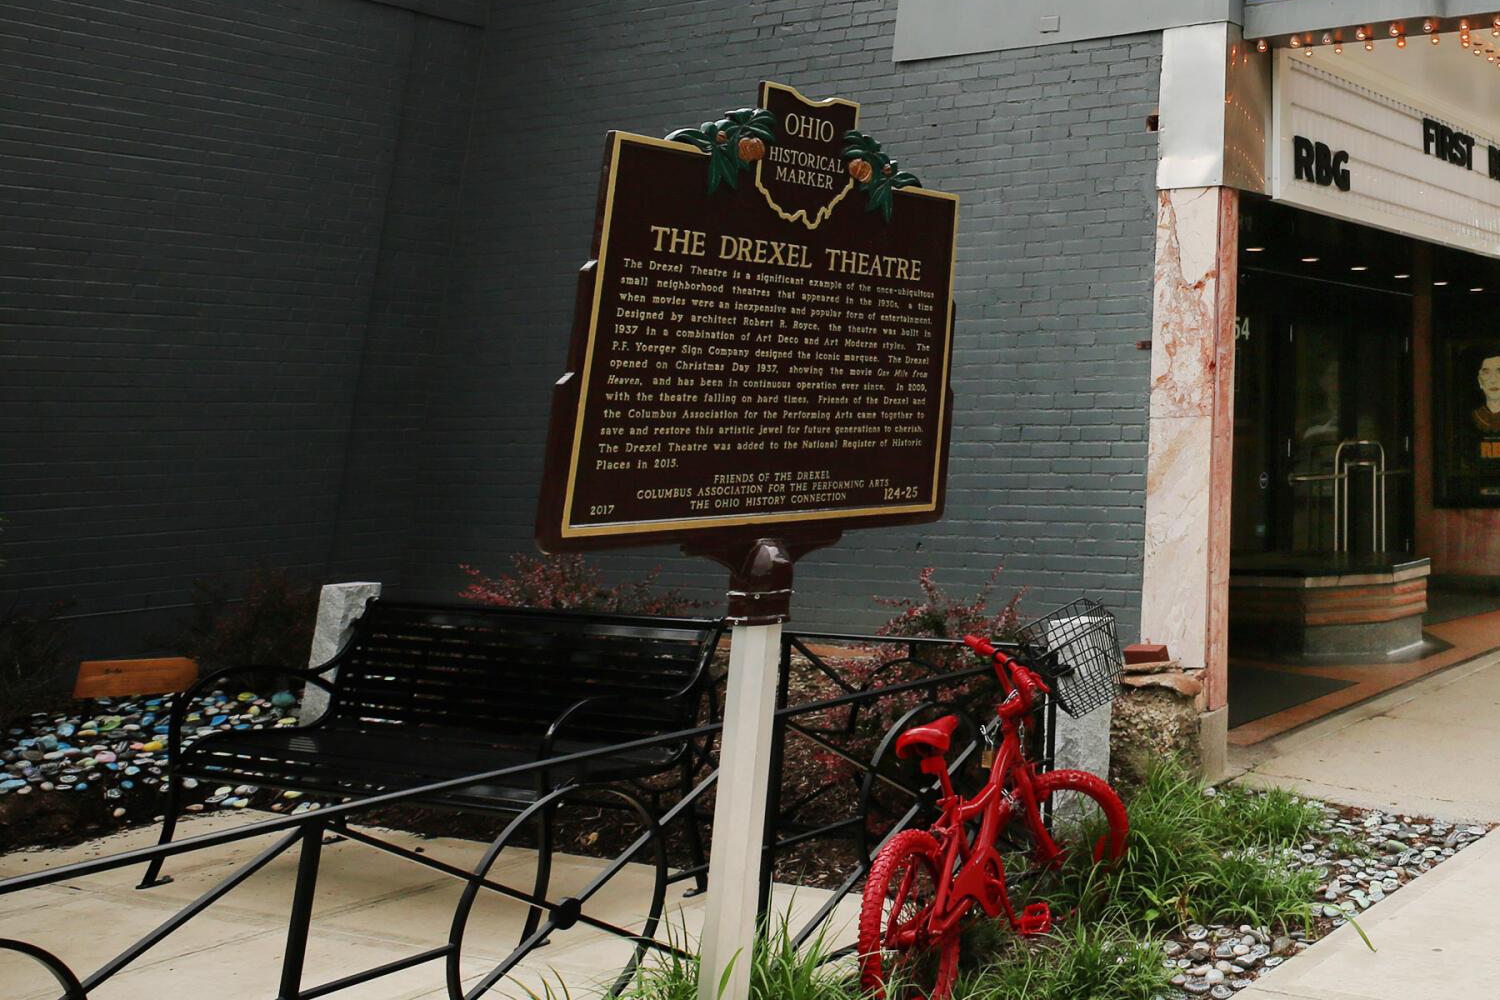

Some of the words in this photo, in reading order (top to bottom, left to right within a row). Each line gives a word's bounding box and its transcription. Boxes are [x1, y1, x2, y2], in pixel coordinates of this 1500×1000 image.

[784, 112, 835, 144] OHIO
[1423, 117, 1475, 171] FIRST
[769, 146, 845, 174] HISTORICAL
[1293, 135, 1351, 192] RBG
[776, 165, 834, 191] MARKER
[649, 224, 707, 257] THE
[717, 234, 813, 269] DREXEL
[824, 247, 922, 281] THEATRE
[623, 257, 642, 269] The
[649, 260, 683, 273] Drexel
[690, 265, 727, 277] Theatre
[732, 269, 740, 279] is
[745, 272, 751, 280] a
[756, 272, 804, 285] significant
[808, 279, 842, 290] example
[846, 282, 855, 290] of
[858, 283, 871, 292] the
[620, 276, 648, 286] small
[656, 279, 724, 293] neighborhood
[732, 285, 770, 297] theatres
[777, 290, 795, 299] that
[801, 293, 840, 303] appeared
[845, 295, 854, 304] in
[859, 297, 872, 306] the
[619, 292, 646, 302] when
[652, 295, 686, 305] movies
[691, 298, 714, 308] were
[718, 301, 730, 309] an
[734, 301, 786, 313] inexpensive
[790, 306, 806, 315] and
[810, 308, 842, 318] popular
[846, 310, 864, 319] form
[867, 312, 876, 320] of
[616, 307, 664, 321] Designed
[670, 311, 684, 322] by
[690, 314, 737, 325] architect
[743, 316, 773, 327] Robert
[779, 319, 787, 328] R.
[828, 323, 842, 332] the
[615, 323, 638, 334] 1937
[646, 325, 656, 335] in
[663, 328, 668, 336] a
[675, 329, 734, 340] combination
[740, 332, 751, 341] of
[755, 333, 772, 342] Art
[777, 334, 799, 344] Deco
[803, 336, 819, 345] and
[823, 337, 838, 346] Art
[844, 338, 877, 348] Moderne
[916, 343, 930, 351] The
[612, 340, 630, 351] P.F.
[635, 342, 676, 355] Yoerger
[681, 344, 702, 356] Sign
[708, 345, 749, 357] Company
[754, 348, 793, 360] designed
[797, 350, 811, 359] the
[815, 351, 840, 361] iconic
[887, 355, 901, 363] The
[609, 359, 648, 369] opened
[655, 361, 668, 369] on
[675, 360, 724, 371] Christmas
[731, 362, 750, 373] Day
[789, 365, 823, 376] showing
[830, 366, 844, 375] the
[849, 367, 872, 376] movie
[652, 376, 671, 385] and
[677, 376, 694, 386] has
[699, 377, 723, 387] been
[728, 378, 738, 387] in
[742, 379, 791, 388] continuous
[796, 381, 837, 390] operation
[605, 391, 630, 401] with
[636, 391, 653, 401] the
[659, 392, 698, 402] theatre
[703, 392, 736, 404] falling
[741, 395, 752, 403] on
[756, 394, 778, 403] hard
[818, 394, 848, 404] Friends
[853, 396, 862, 404] of
[866, 396, 878, 404] the
[883, 395, 909, 405] Drexel
[603, 408, 621, 418] the
[627, 408, 676, 418] Columbus
[682, 409, 738, 419] Association
[744, 409, 758, 419] for
[763, 410, 778, 419] the
[782, 409, 831, 420] Performing
[834, 410, 853, 419] Arts
[856, 411, 877, 419] came
[600, 427, 624, 435] save
[629, 425, 649, 435] and
[653, 426, 691, 435] restore
[695, 425, 713, 435] this
[718, 425, 754, 434] artistic
[758, 424, 783, 435] jewel
[787, 424, 800, 434] for
[804, 425, 831, 433] future
[834, 424, 880, 435] generations
[598, 443, 618, 453] The
[625, 442, 661, 452] Drexel
[668, 442, 708, 452] Theatre
[736, 441, 764, 450] added
[769, 441, 779, 449] to
[783, 440, 798, 449] the
[802, 439, 838, 448] National
[842, 439, 876, 449] Register
[891, 438, 922, 447] Historic
[595, 459, 631, 470] Places
[636, 458, 648, 470] in
[653, 457, 679, 469] 2015.
[712, 472, 755, 485] FRIENDS
[757, 472, 770, 483] OF
[773, 471, 792, 482] THE
[795, 470, 831, 481] DREXEL
[636, 487, 692, 500] COLUMBUS
[695, 483, 764, 497] ASSOCIATION
[767, 483, 786, 493] FOR
[788, 481, 808, 492] THE
[811, 479, 865, 491] PERFORMING
[867, 478, 889, 488] ARTS
[883, 485, 918, 500] 124-25
[589, 504, 615, 516] 2017
[689, 498, 711, 510] THE
[713, 497, 740, 509] OHIO
[744, 494, 787, 507] HISTORY
[790, 491, 847, 504] CONNECTION
